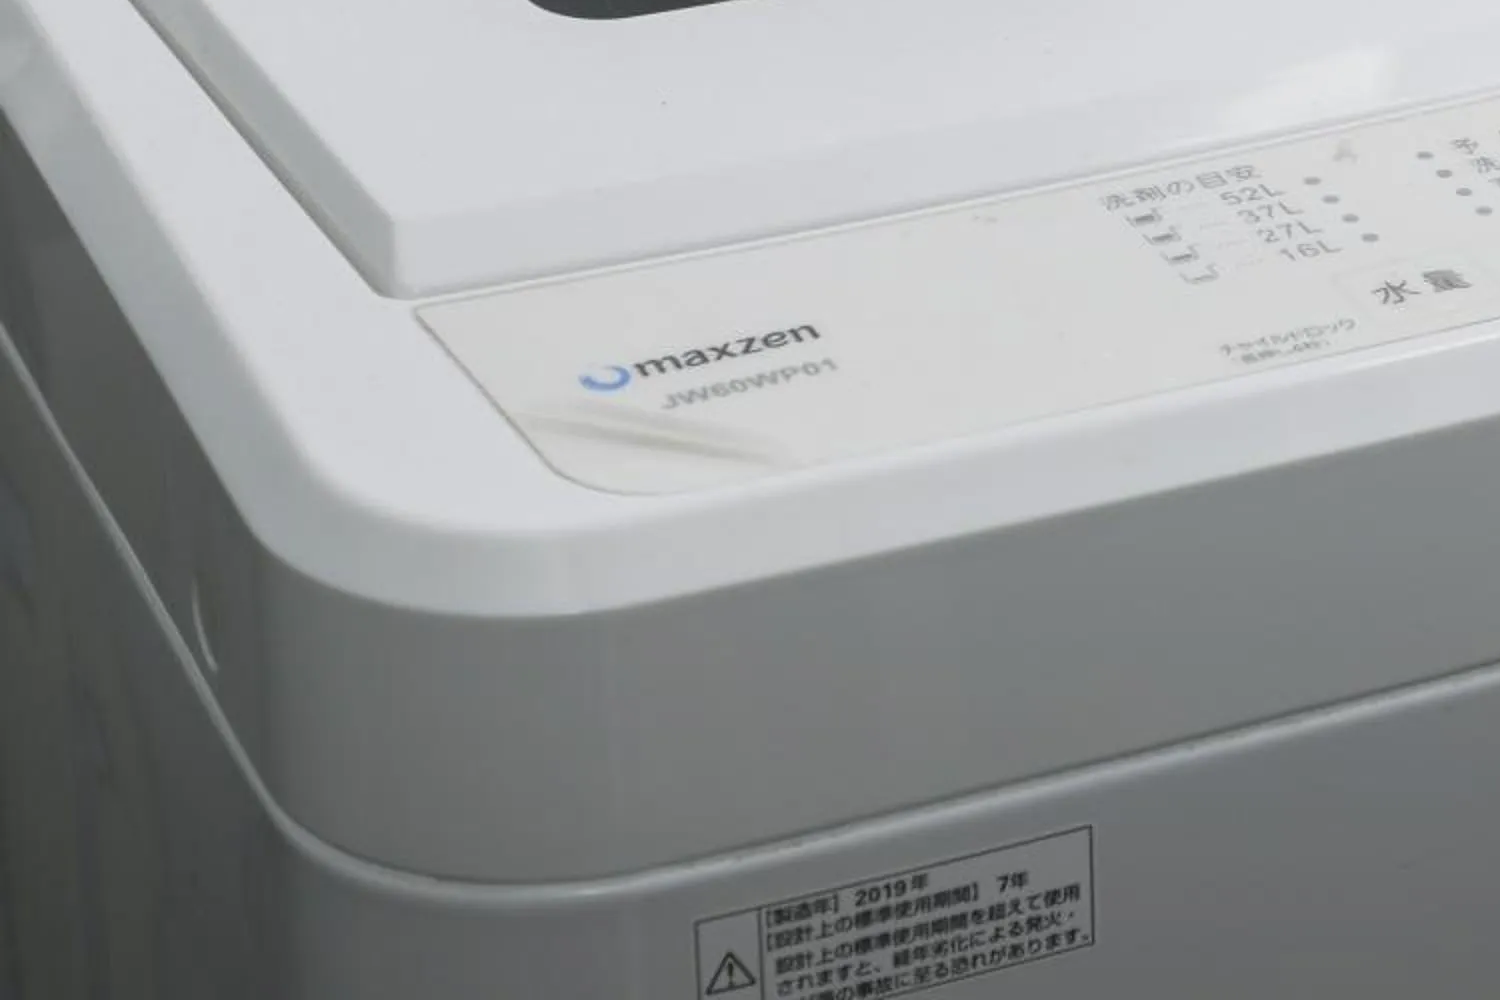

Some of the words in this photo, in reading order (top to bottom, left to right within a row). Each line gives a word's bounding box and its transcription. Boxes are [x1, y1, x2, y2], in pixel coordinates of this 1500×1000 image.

[1100, 165, 1263, 211] 洗剤の目安
[1220, 183, 1285, 206] 52L
[1237, 200, 1304, 224] 37L
[1257, 219, 1325, 244] 27L
[1278, 240, 1344, 262] 16L
[634, 321, 822, 378] maxzen
[660, 356, 839, 410] JW60WP01
